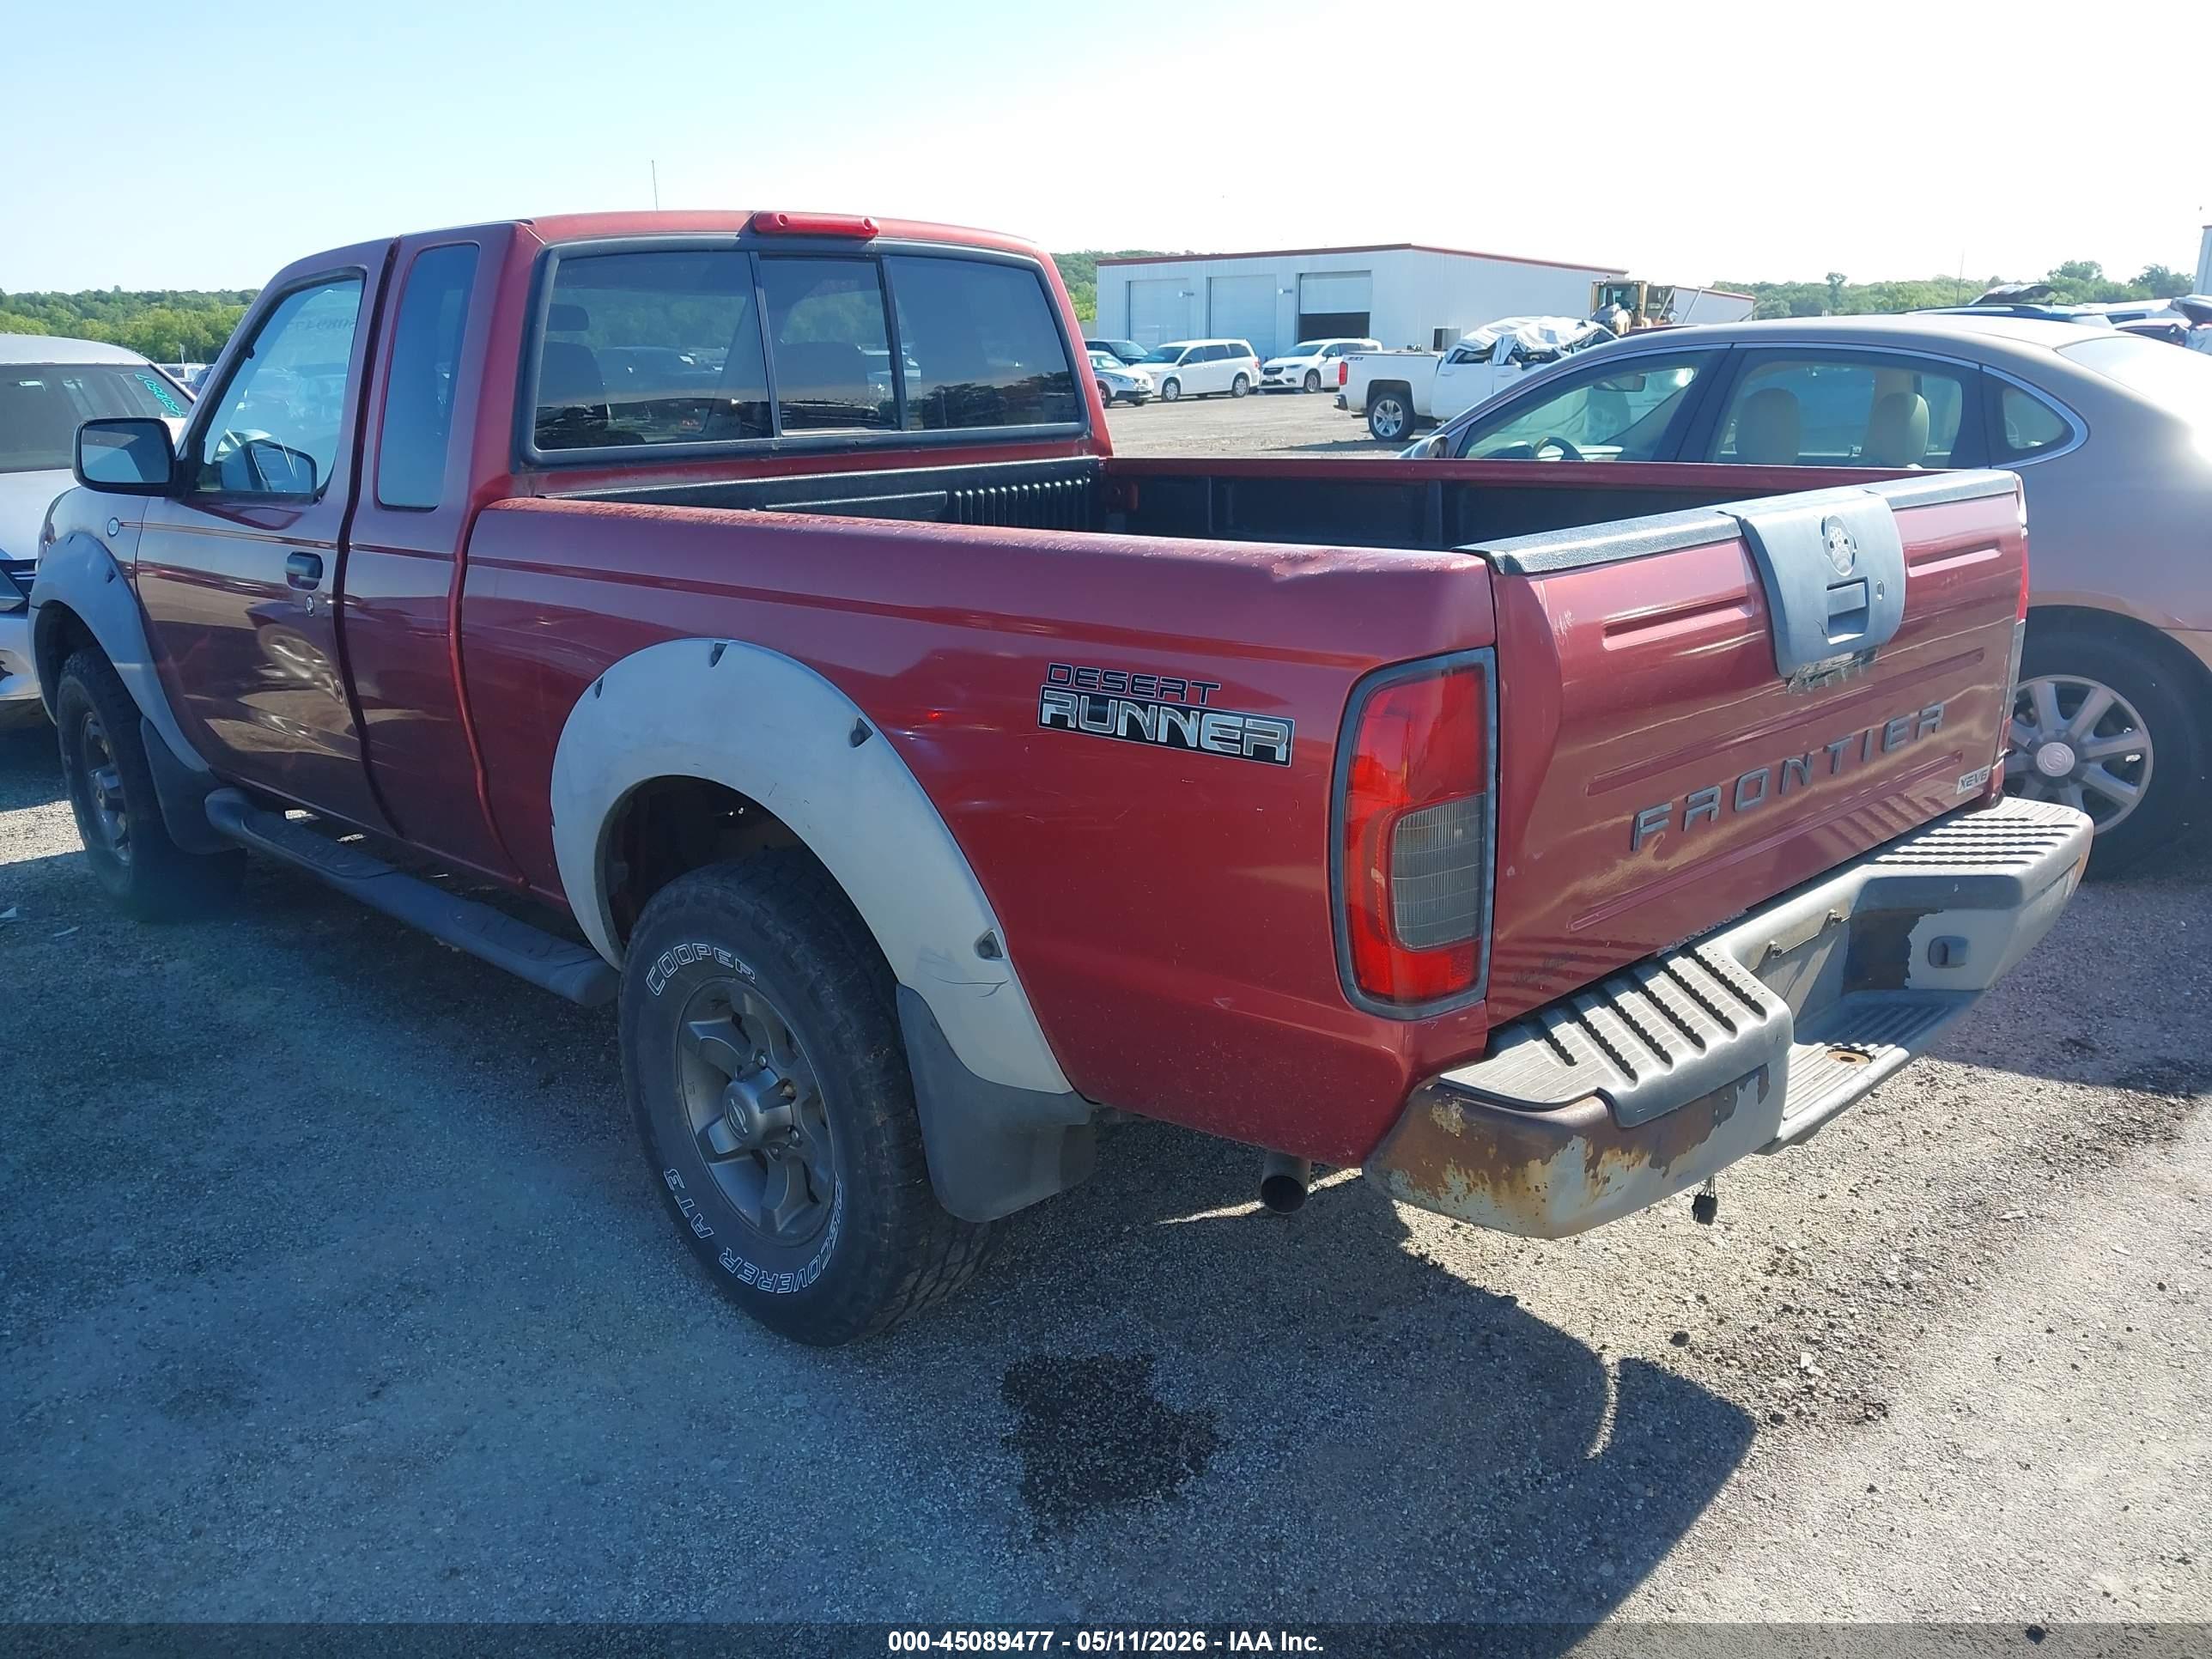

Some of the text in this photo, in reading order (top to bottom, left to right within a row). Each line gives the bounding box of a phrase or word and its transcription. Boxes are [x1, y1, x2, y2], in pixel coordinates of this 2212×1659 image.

[1046, 661, 1221, 706] DESERT
[1040, 689, 1289, 763] RUNNER
[1632, 701, 1945, 853] FRONTIER
[645, 942, 757, 997] COOPER
